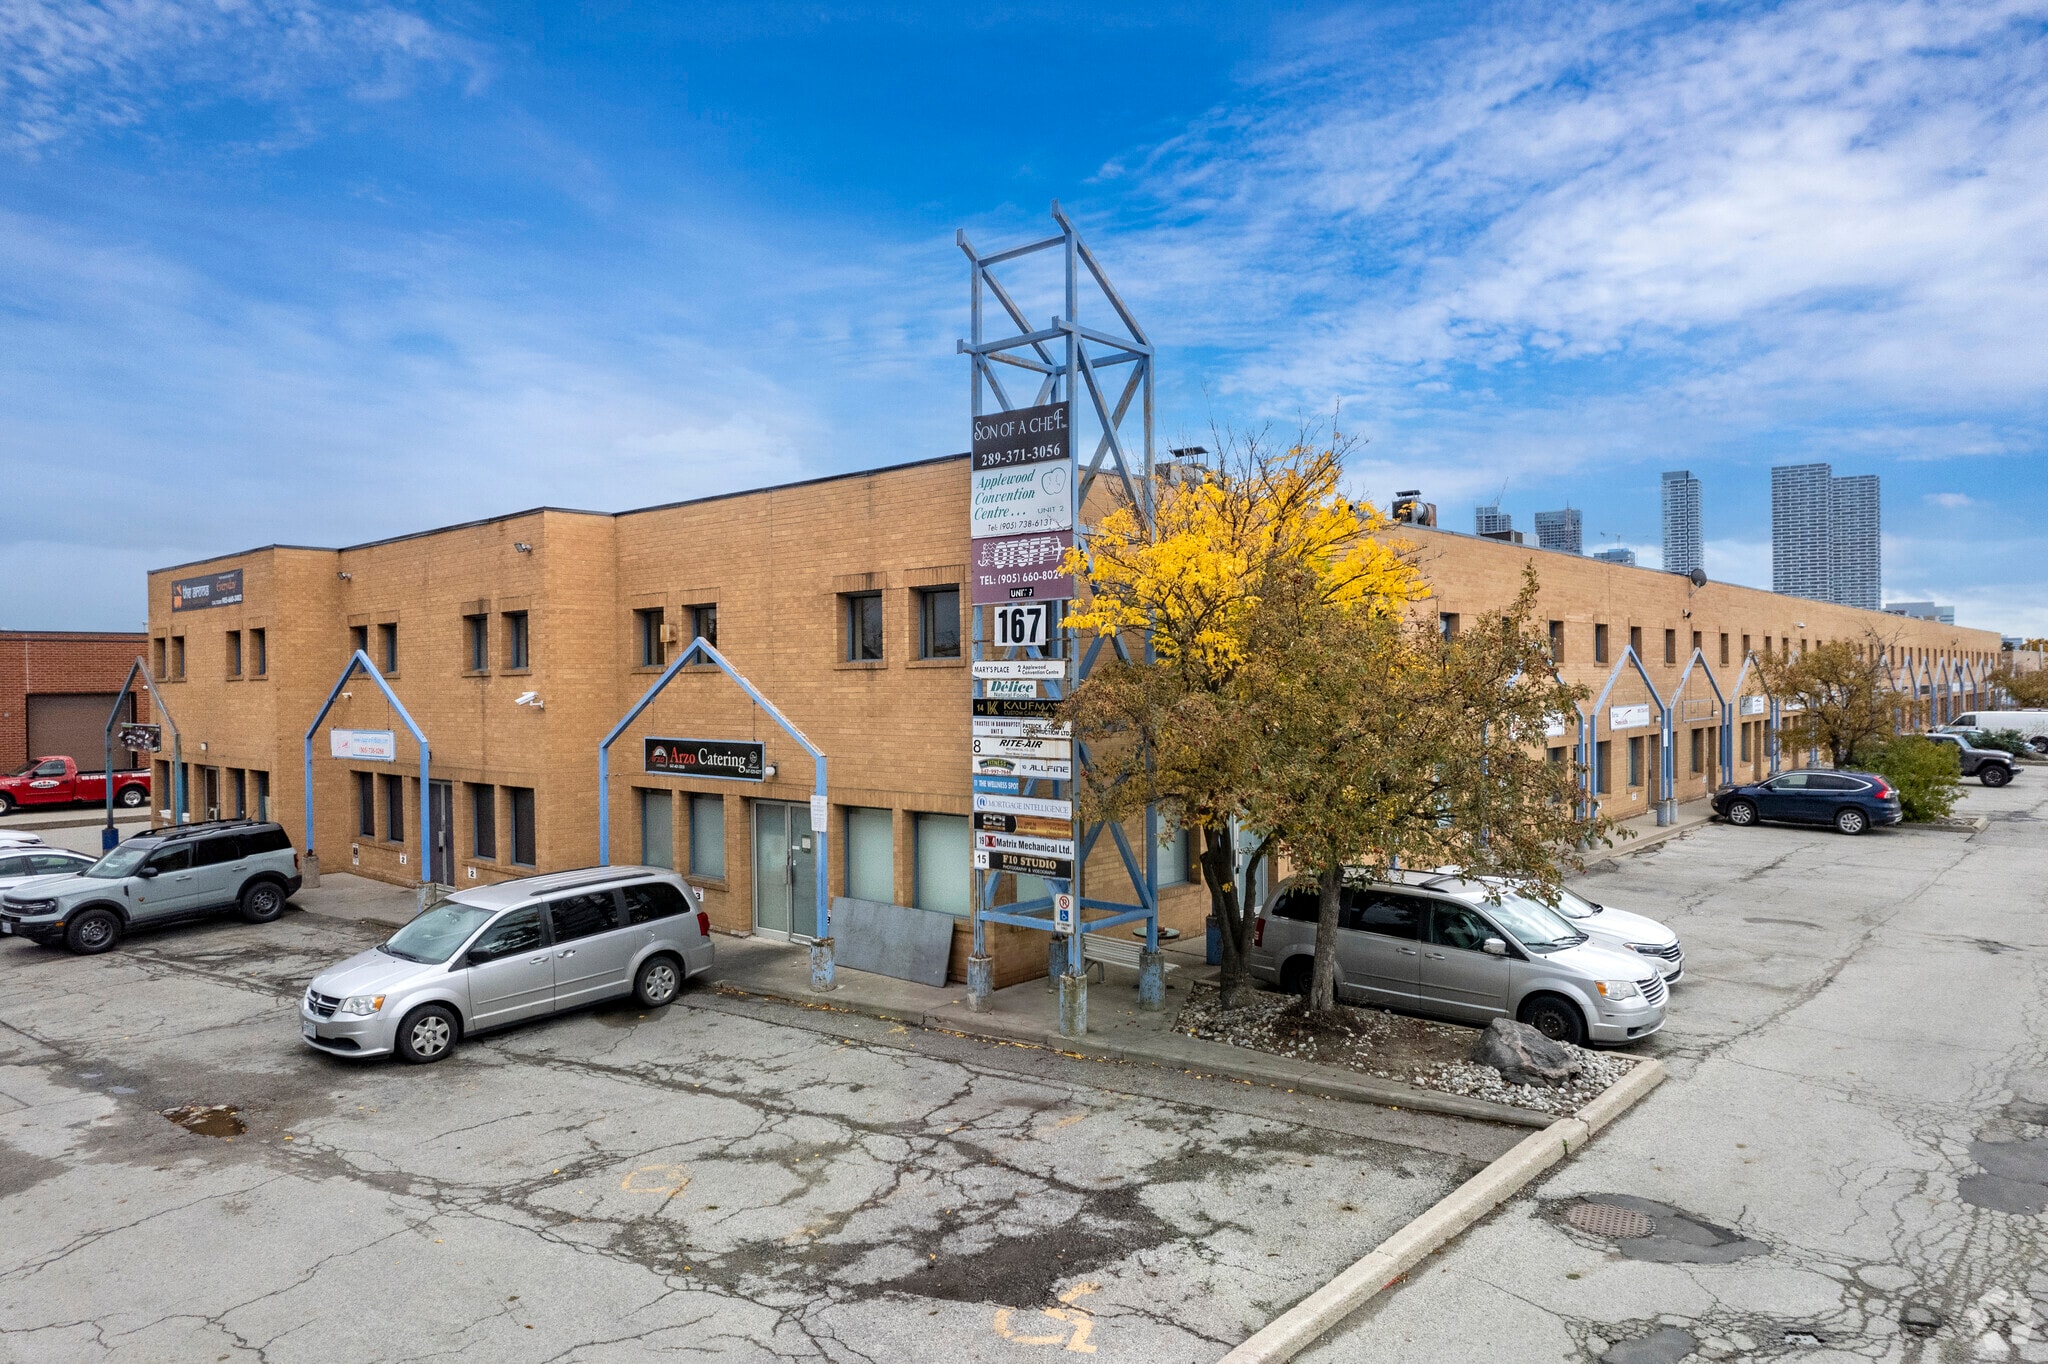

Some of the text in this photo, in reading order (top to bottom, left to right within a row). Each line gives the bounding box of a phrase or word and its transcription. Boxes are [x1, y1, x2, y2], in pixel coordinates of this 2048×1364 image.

[1000, 422, 1015, 437] OF
[1018, 421, 1026, 434] A
[1029, 408, 1063, 432] CHEF
[982, 443, 1060, 466] 289-371-3056
[976, 469, 1036, 490] Applewood
[975, 487, 1035, 505] Convention
[1000, 521, 1017, 530] (905)
[1018, 519, 1052, 528] 738-6131
[980, 576, 996, 585] TEL:
[998, 574, 1020, 584] (905)
[998, 608, 1041, 643] 167
[991, 681, 1033, 692] Délice
[1004, 701, 1056, 710] KAUFMA
[974, 740, 981, 753] 8
[1000, 739, 1042, 748] RITE-AIR
[670, 746, 746, 773] Arzo Catering
[989, 801, 1069, 814] MORTGAGE INTELLIGENCE
[997, 839, 1072, 854] Matrix Mechanical Ltd.
[977, 855, 986, 863] 15
[1003, 855, 1056, 870] F10 STUDIO
